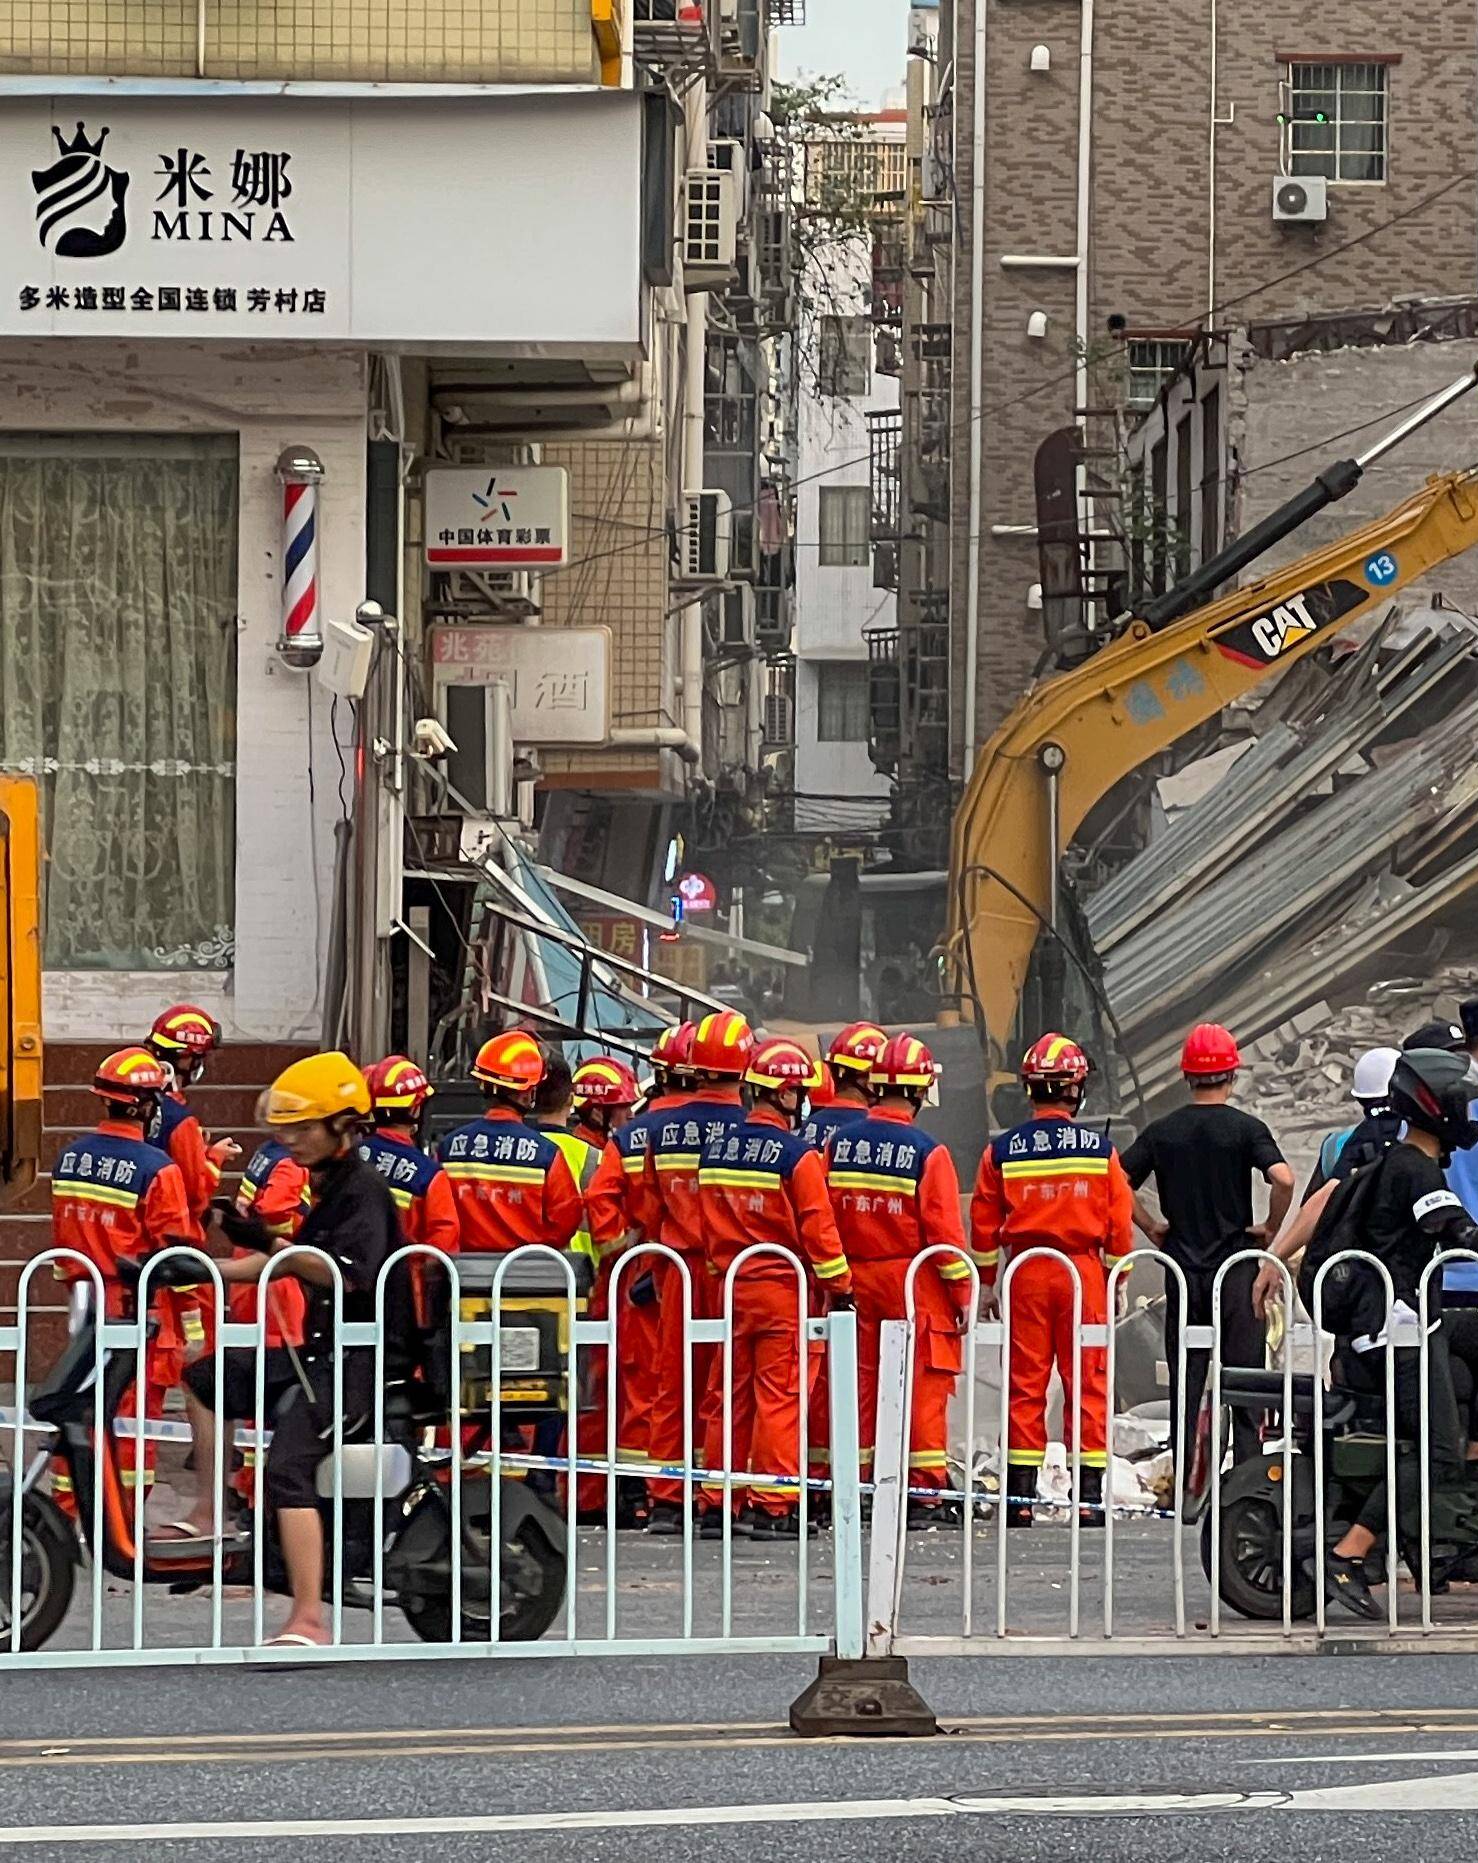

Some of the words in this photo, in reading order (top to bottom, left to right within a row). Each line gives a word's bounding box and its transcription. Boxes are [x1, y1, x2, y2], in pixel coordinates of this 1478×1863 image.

[154, 147, 293, 209] 米娜
[150, 210, 296, 242] MINA
[19, 285, 238, 313] 多米造型全国连锁
[247, 286, 327, 314] 芳村店
[438, 527, 551, 546] 中国体育彩票
[1368, 555, 1396, 581] 13
[1250, 593, 1318, 658] CAT
[449, 1133, 540, 1162] 应急消防
[707, 1136, 784, 1164] 应急消防
[833, 1138, 917, 1169] 应急消防
[1009, 1126, 1101, 1155] 应急消防
[59, 1150, 138, 1185] 应急消防
[1023, 1179, 1089, 1201] 广东广州
[842, 1194, 904, 1216] 广东广州
